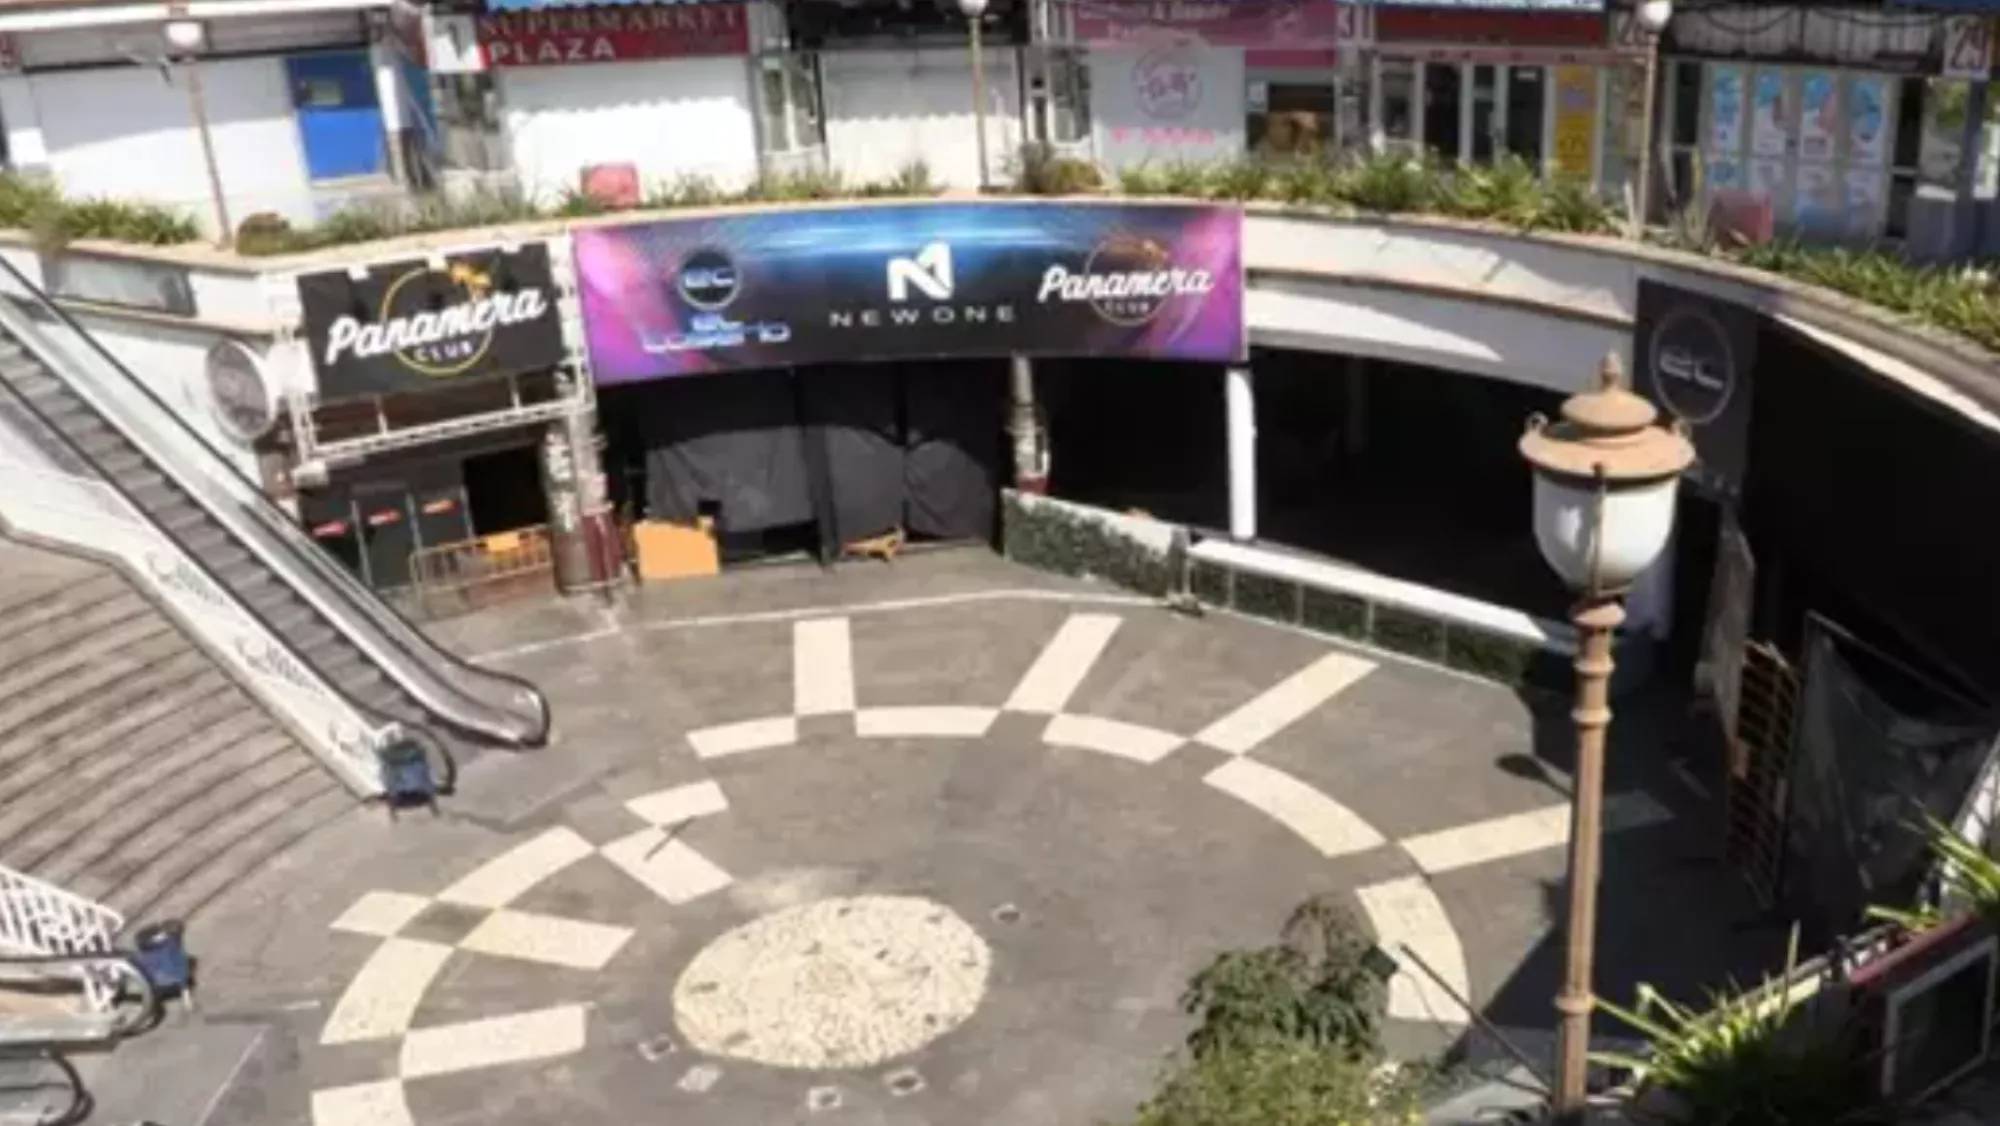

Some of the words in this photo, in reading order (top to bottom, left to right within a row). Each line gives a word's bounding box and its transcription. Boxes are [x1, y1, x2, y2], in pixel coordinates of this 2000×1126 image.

[479, 8, 737, 36] SUPERMARKET
[490, 37, 617, 64] PLAZA
[1036, 263, 1215, 303] Panamera
[323, 287, 548, 366] Panamera
[411, 340, 475, 362] CLUB
